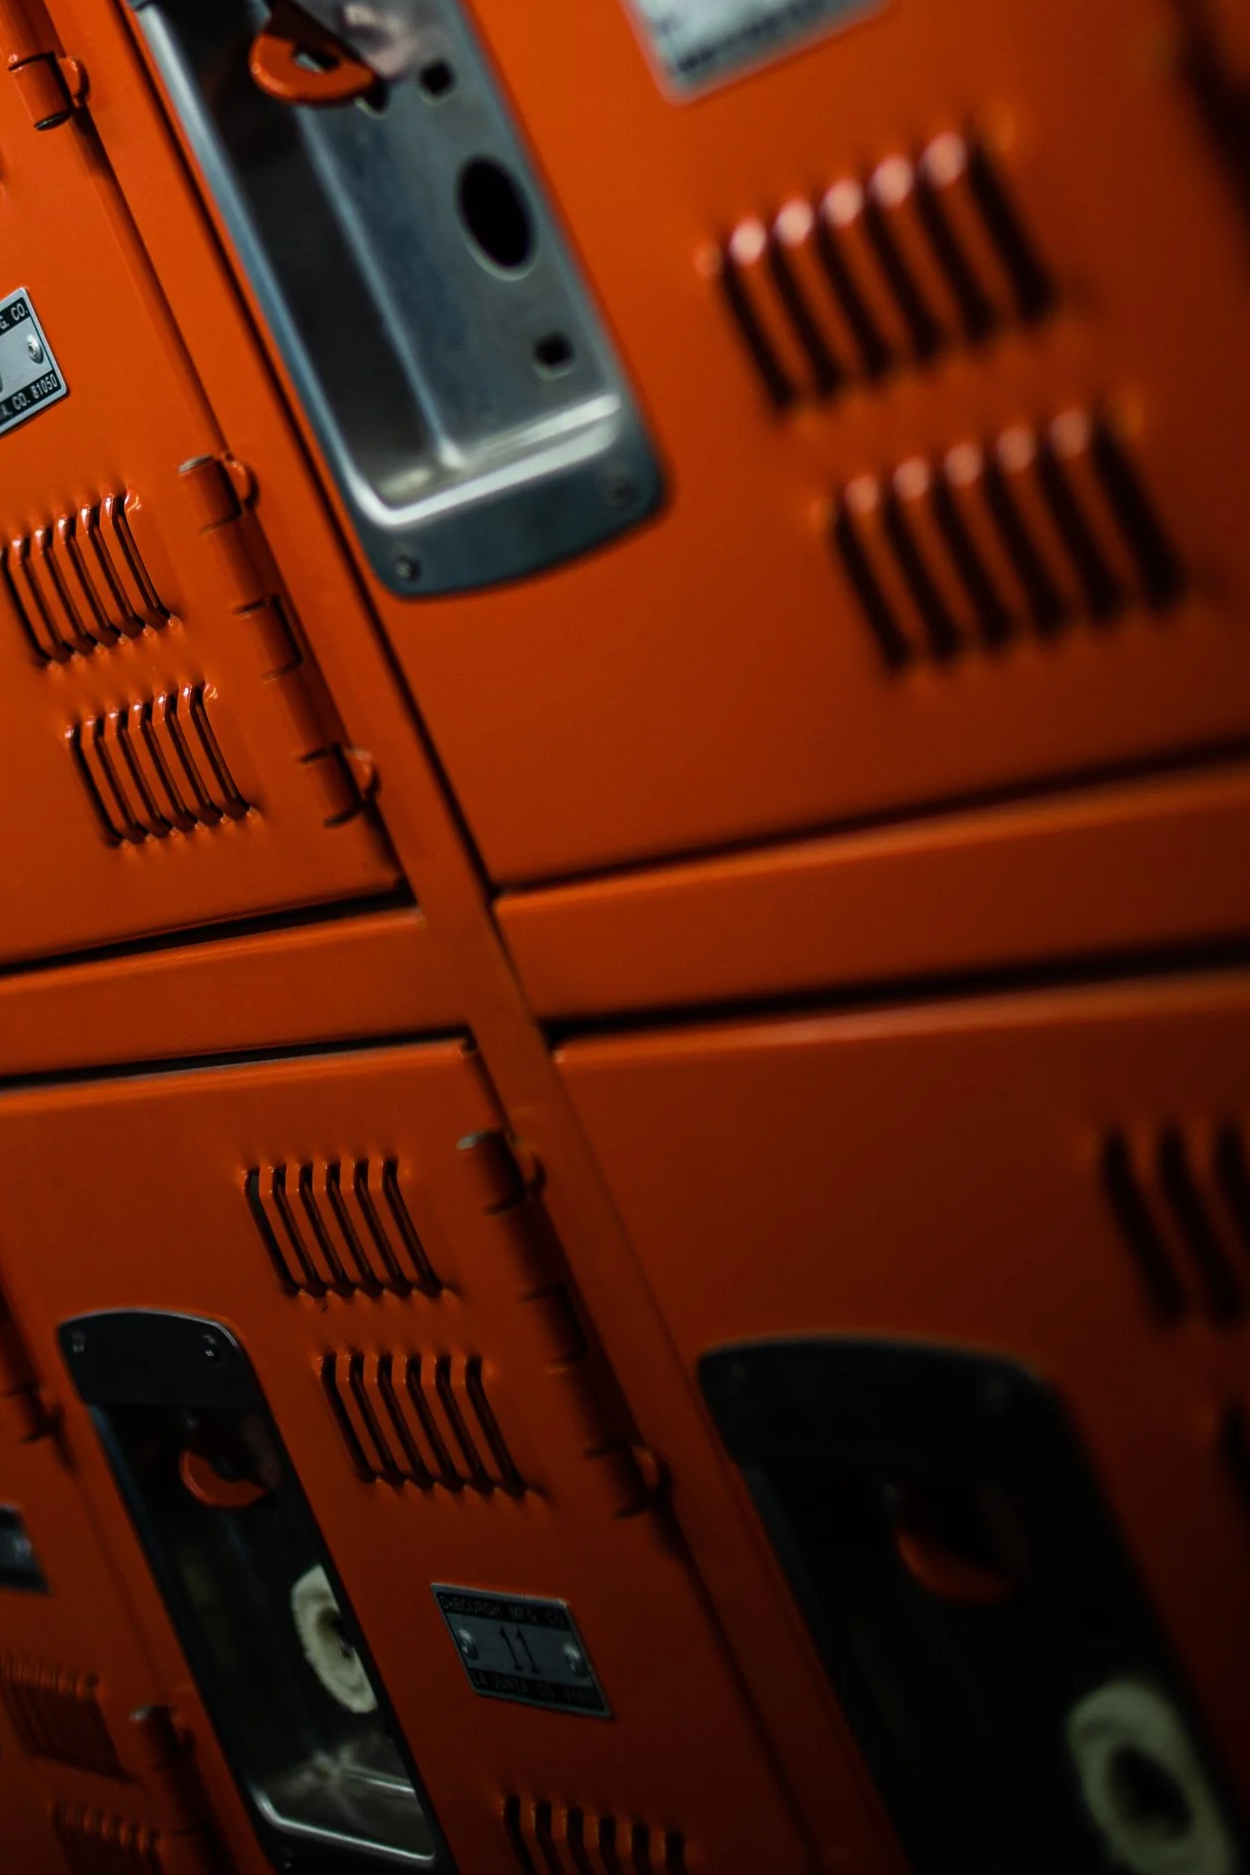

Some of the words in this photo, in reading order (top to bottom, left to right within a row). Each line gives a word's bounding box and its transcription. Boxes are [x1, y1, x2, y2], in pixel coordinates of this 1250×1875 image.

[10, 303, 29, 321] CO.
[11, 392, 31, 411] CO.
[31, 373, 58, 399] 81050
[499, 1623, 542, 1675] 11
